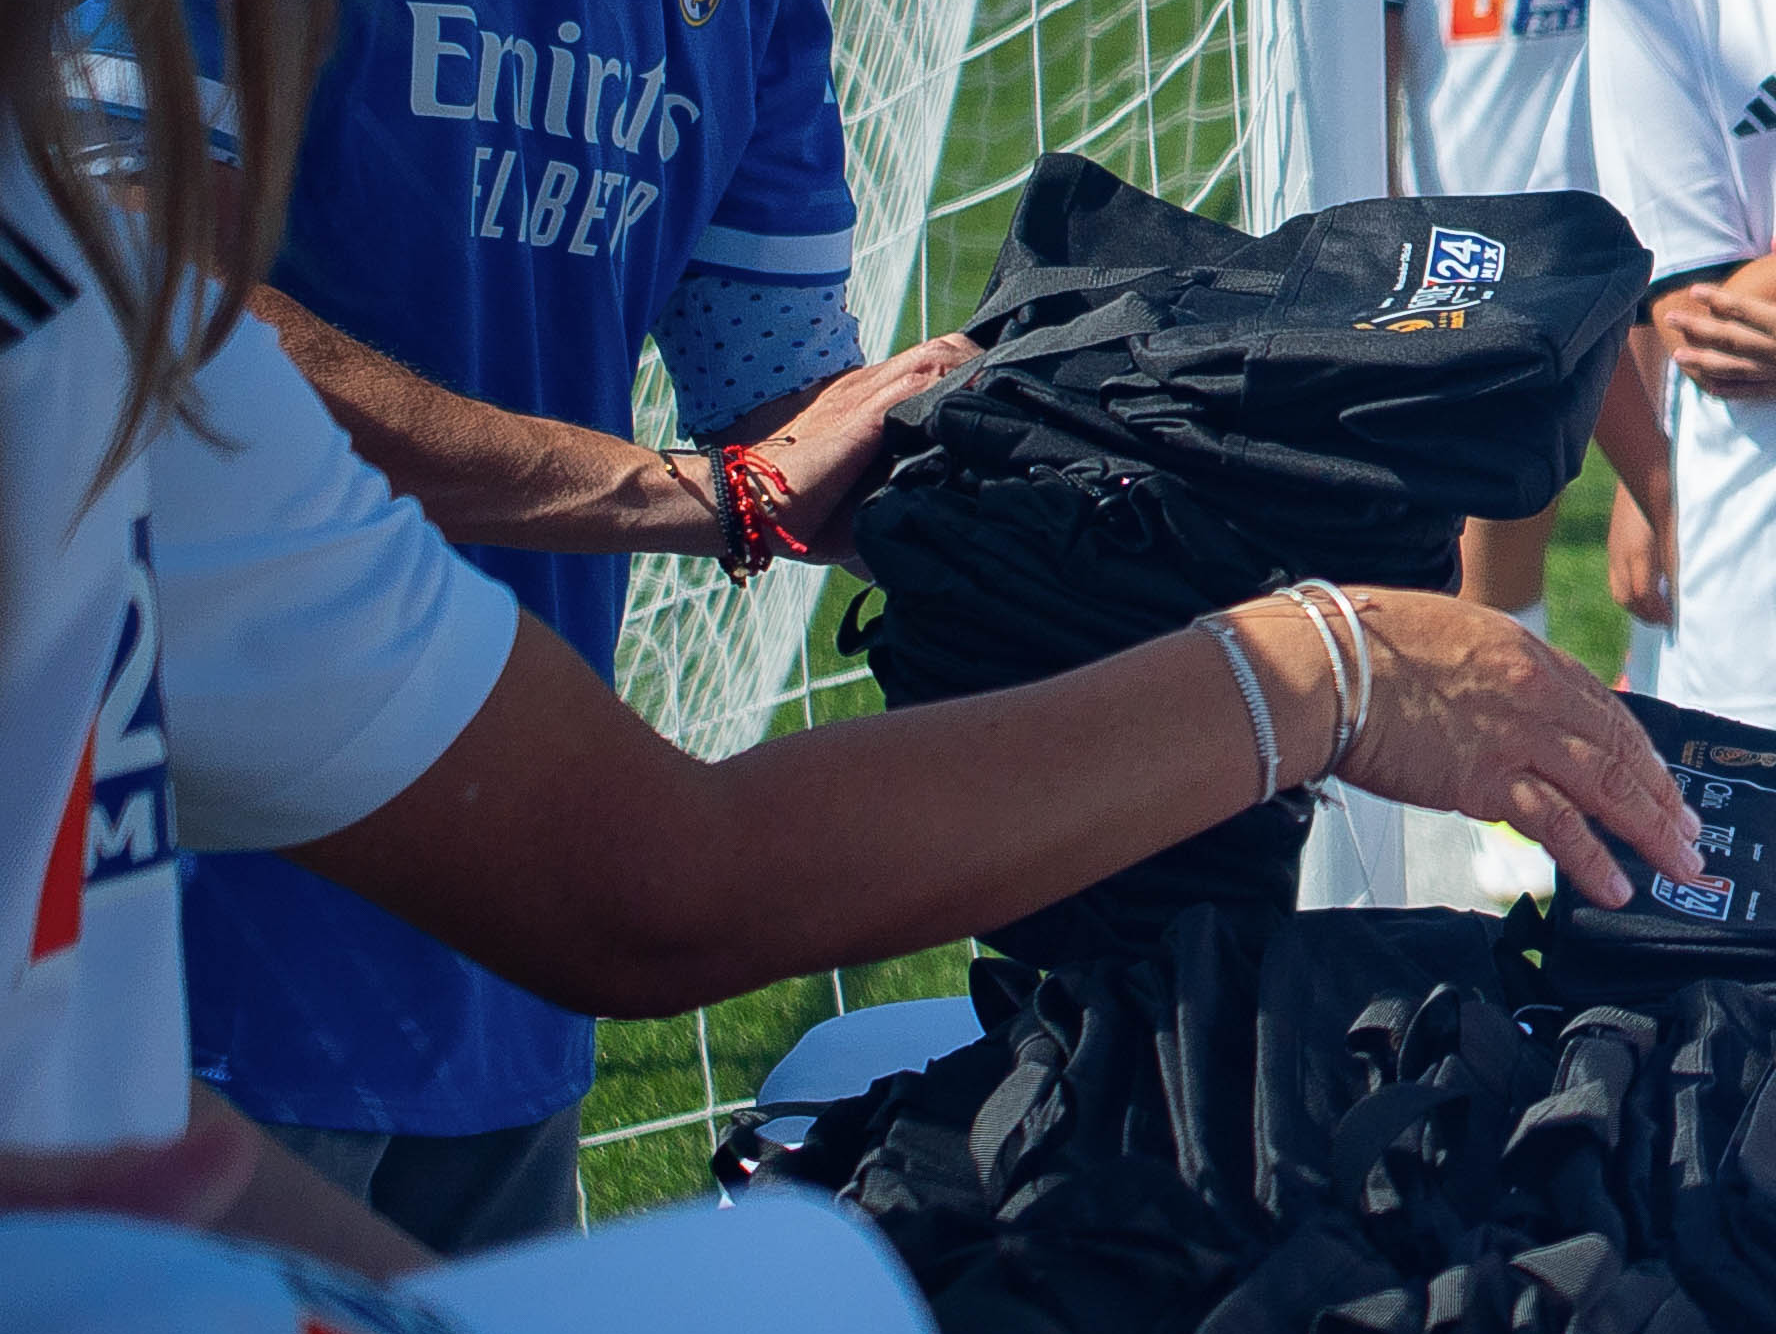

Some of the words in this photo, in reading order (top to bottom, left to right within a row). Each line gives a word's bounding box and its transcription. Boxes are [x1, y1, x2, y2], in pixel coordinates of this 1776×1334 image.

[405, 0, 701, 163] Emirts
[470, 146, 530, 243] FL
[1437, 238, 1482, 280] 24
[95, 563, 170, 783] 2
[1675, 884, 1721, 915] 24
